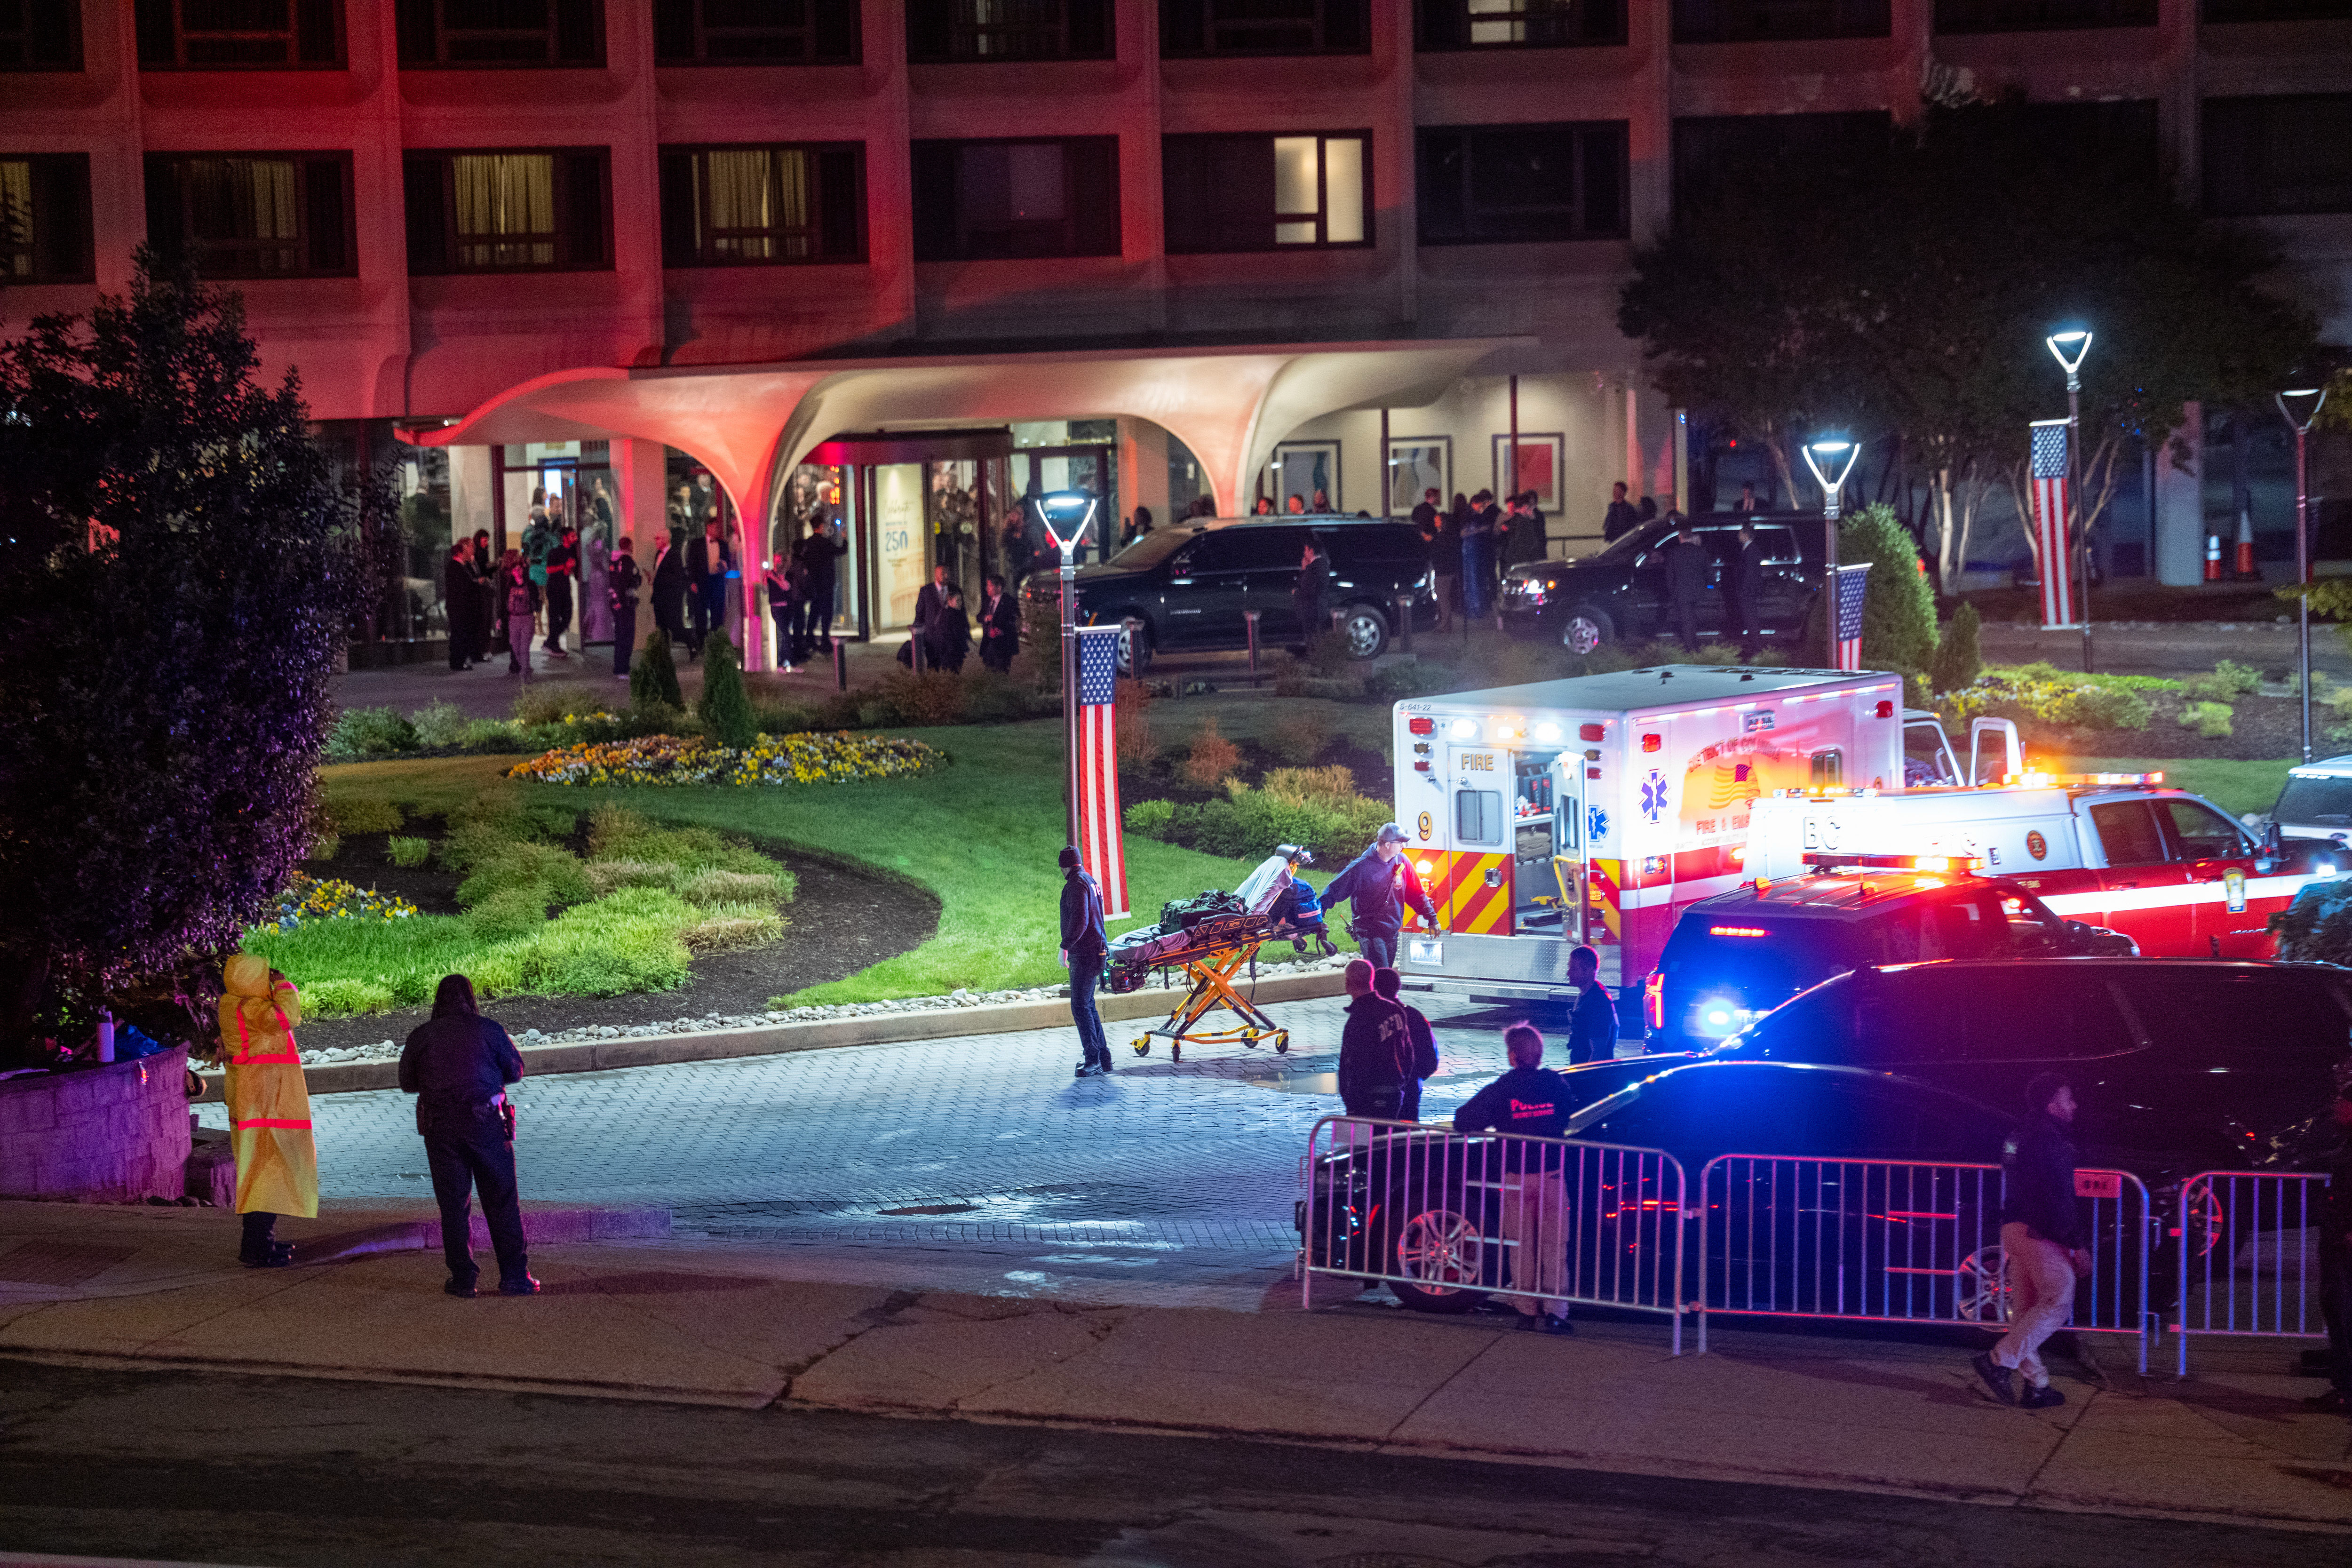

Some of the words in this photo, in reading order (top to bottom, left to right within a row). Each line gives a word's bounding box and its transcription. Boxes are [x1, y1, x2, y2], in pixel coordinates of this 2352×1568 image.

[885, 530, 908, 552] 250
[1462, 753, 1494, 771] FIRE
[1418, 811, 1433, 841] 9
[1803, 816, 1841, 850] BC
